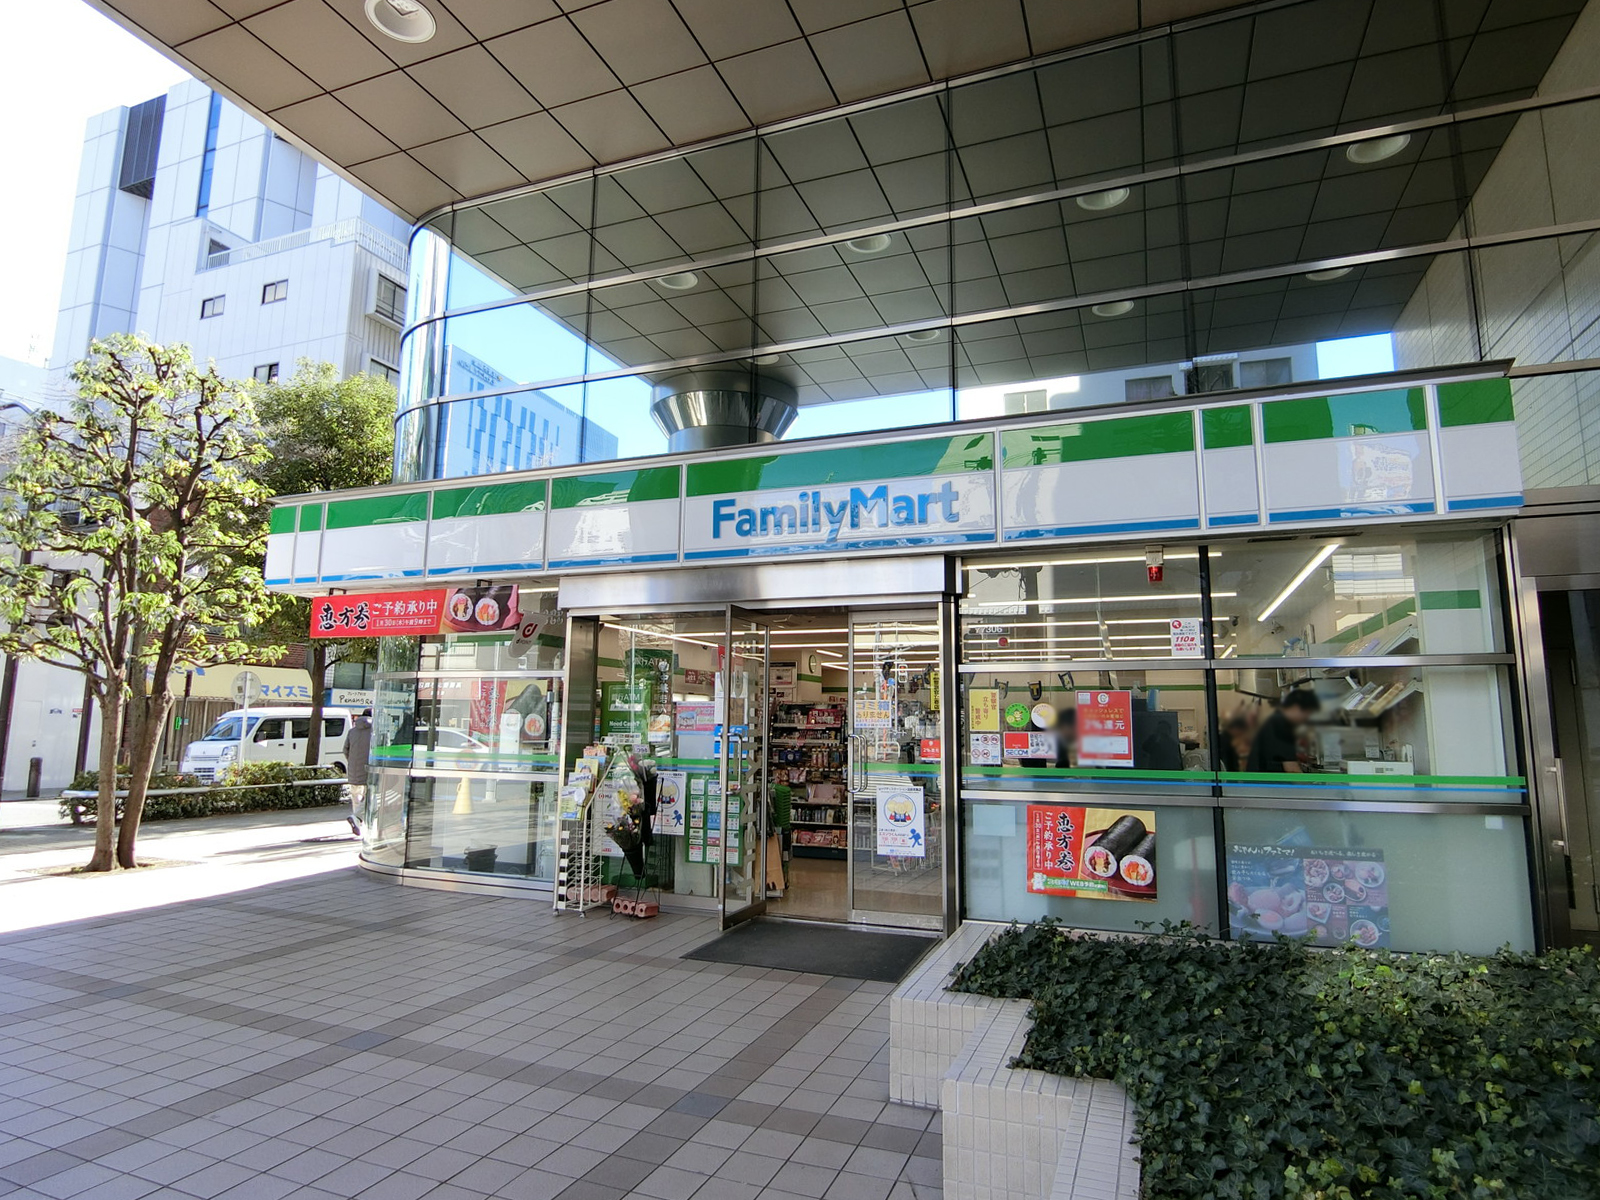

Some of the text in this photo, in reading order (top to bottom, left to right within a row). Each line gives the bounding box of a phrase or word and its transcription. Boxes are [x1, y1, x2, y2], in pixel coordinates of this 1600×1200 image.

[712, 481, 960, 543] FamilyMart
[318, 599, 438, 631] 恵方巻 ご予約承り中
[339, 694, 364, 704] Penang
[1043, 811, 1054, 870] ご予約承り中
[1055, 811, 1075, 872] 恵方巻
